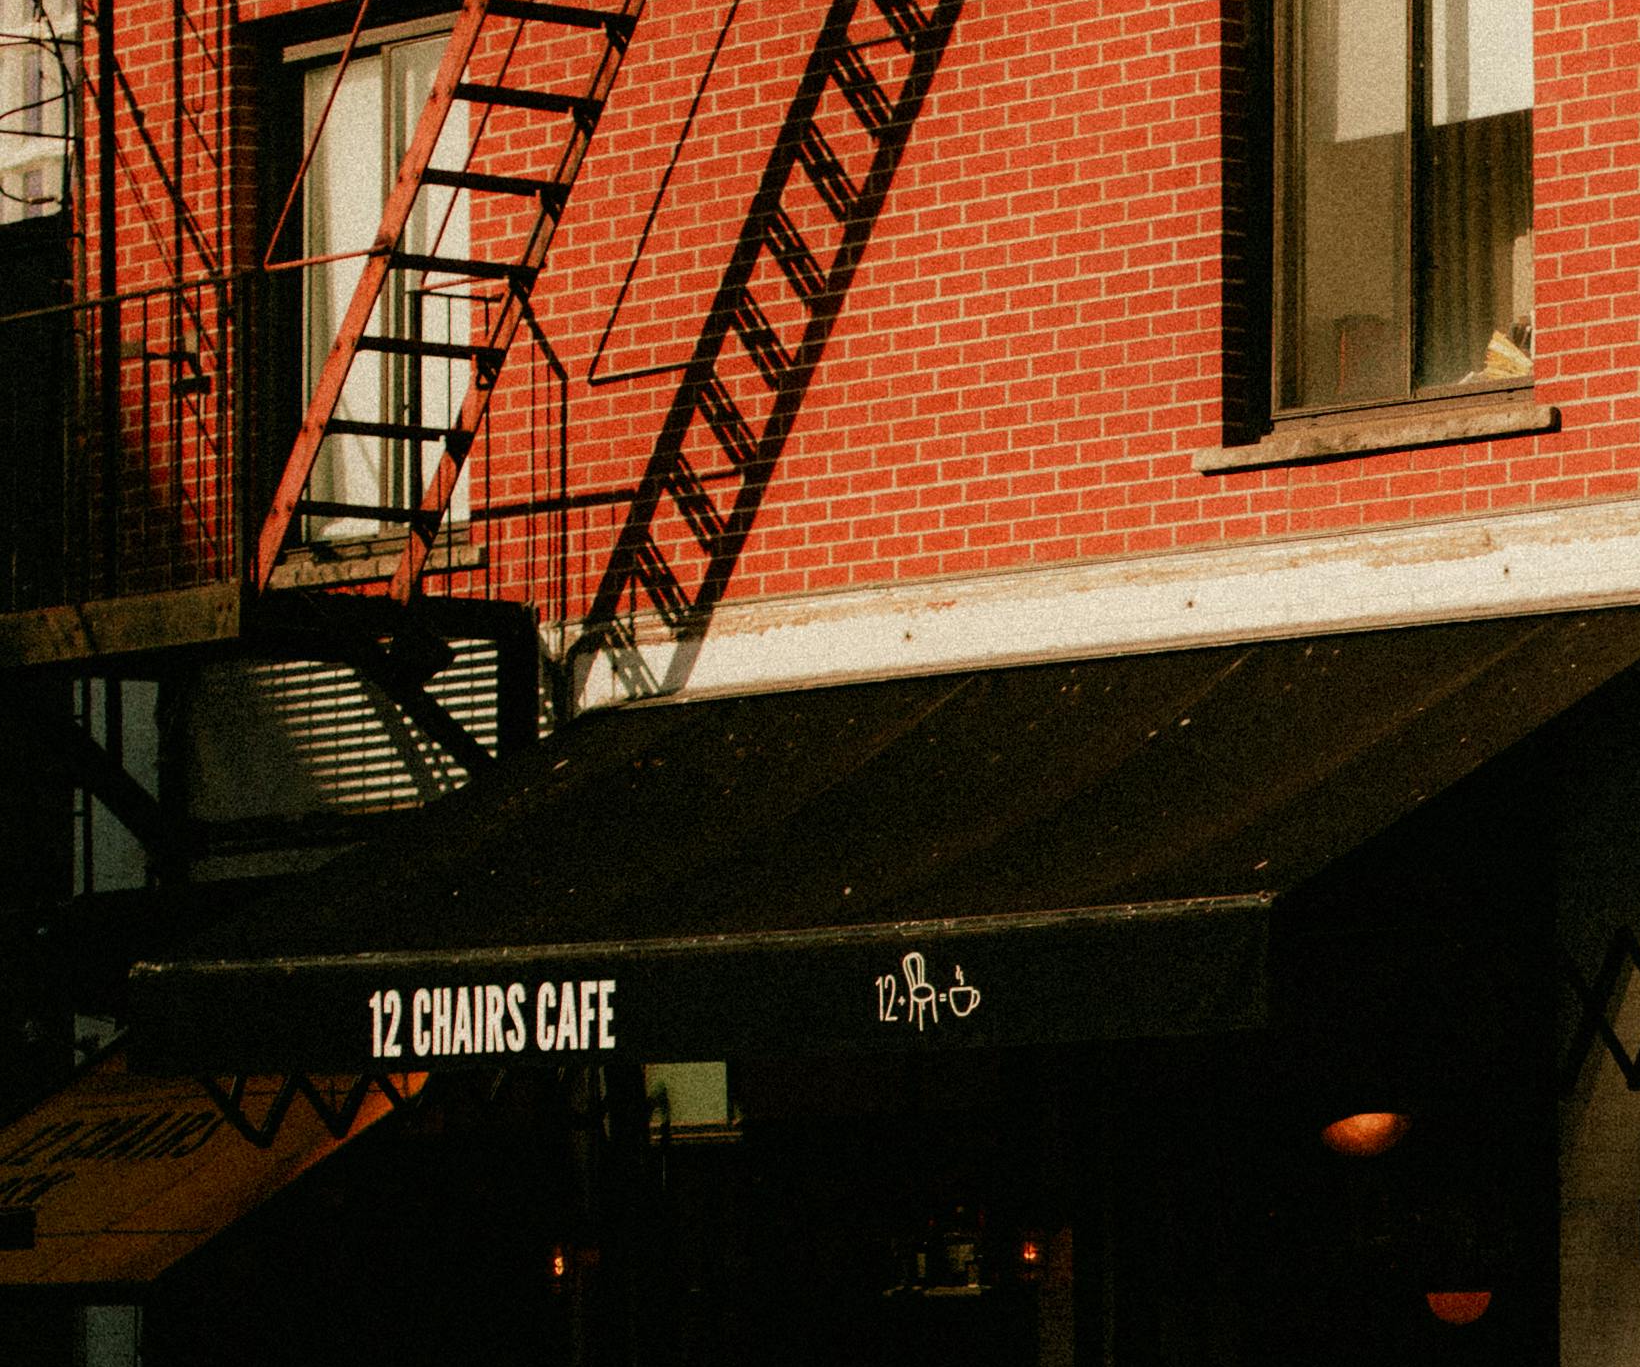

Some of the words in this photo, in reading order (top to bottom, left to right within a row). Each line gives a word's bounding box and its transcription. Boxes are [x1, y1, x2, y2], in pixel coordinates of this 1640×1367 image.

[368, 988, 402, 1058] 12
[412, 982, 527, 1057] CHAIRS
[536, 980, 617, 1052] CAFE
